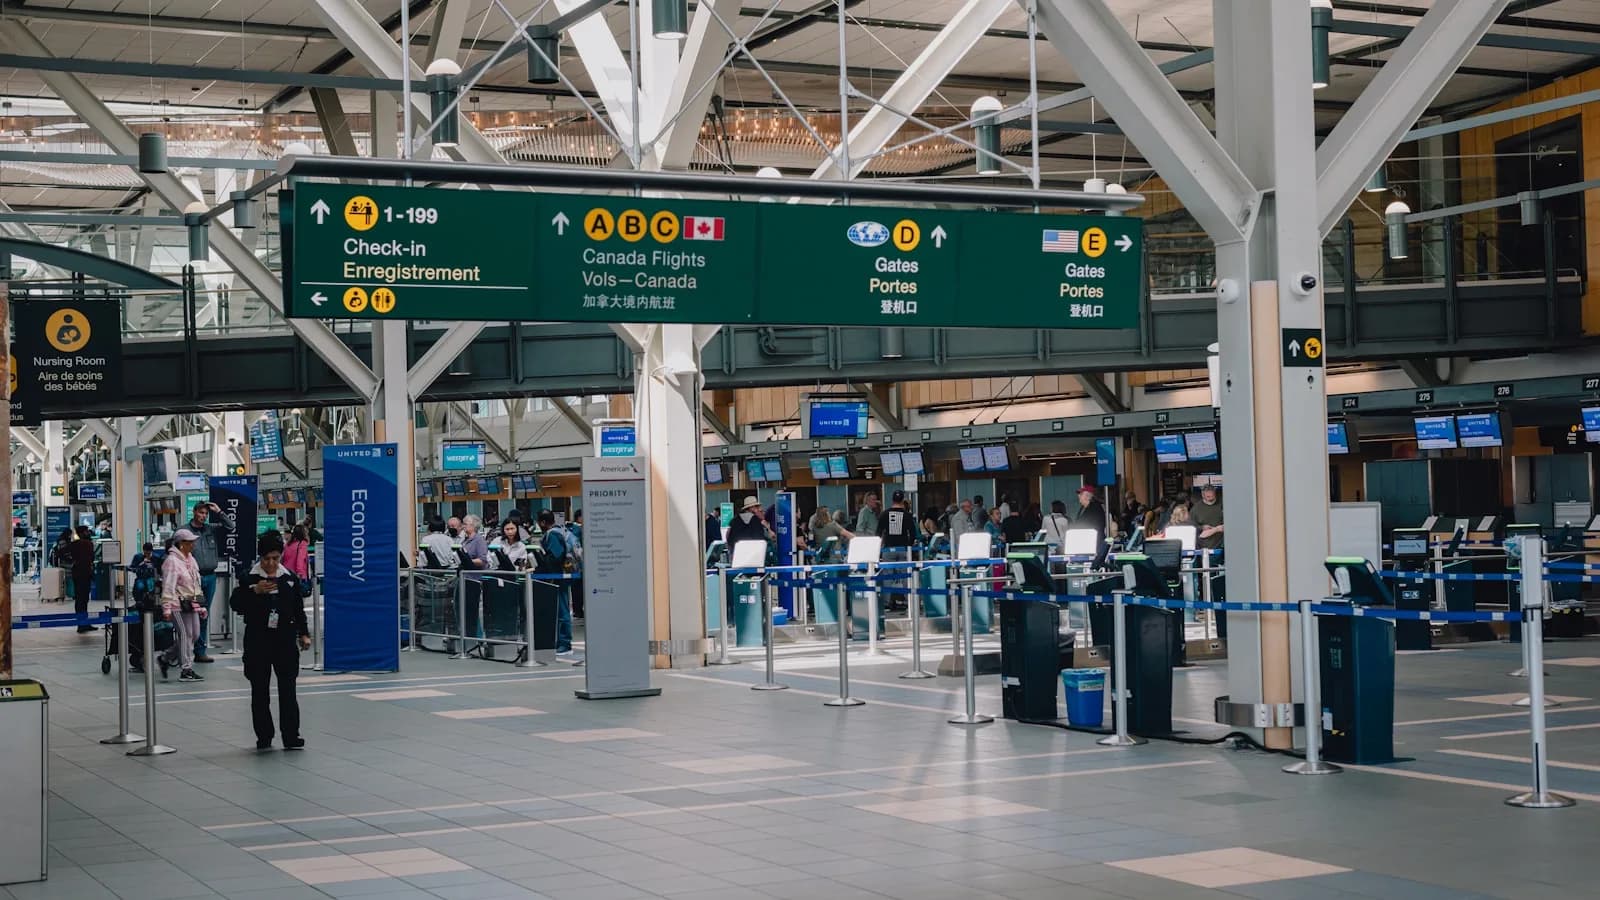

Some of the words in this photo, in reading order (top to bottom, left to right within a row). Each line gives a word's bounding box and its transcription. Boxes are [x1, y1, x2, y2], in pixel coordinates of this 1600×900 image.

[591, 214, 608, 234] A
[625, 215, 641, 235] B
[656, 217, 673, 237] C
[900, 226, 914, 244] D
[1089, 233, 1100, 251] E
[343, 238, 426, 257] Check-in
[583, 248, 647, 266] Canada
[652, 250, 706, 270] Flights
[875, 257, 919, 274] Gates
[343, 262, 481, 283] Enregistrement
[1065, 263, 1105, 279] Gates
[869, 278, 918, 294] Portes
[1060, 283, 1104, 299] Portes
[582, 294, 676, 310] 加拿大境内航班
[880, 300, 918, 314] 登机口
[1070, 304, 1104, 318] 登机口
[33, 357, 73, 368] Nursing
[75, 356, 106, 366] Room
[38, 371, 58, 381] Aire
[61, 371, 74, 381] de
[76, 371, 103, 380] soins
[1586, 379, 1599, 388] 277
[44, 382, 63, 391] des
[66, 381, 97, 391] bébés
[348, 489, 368, 582] Economy
